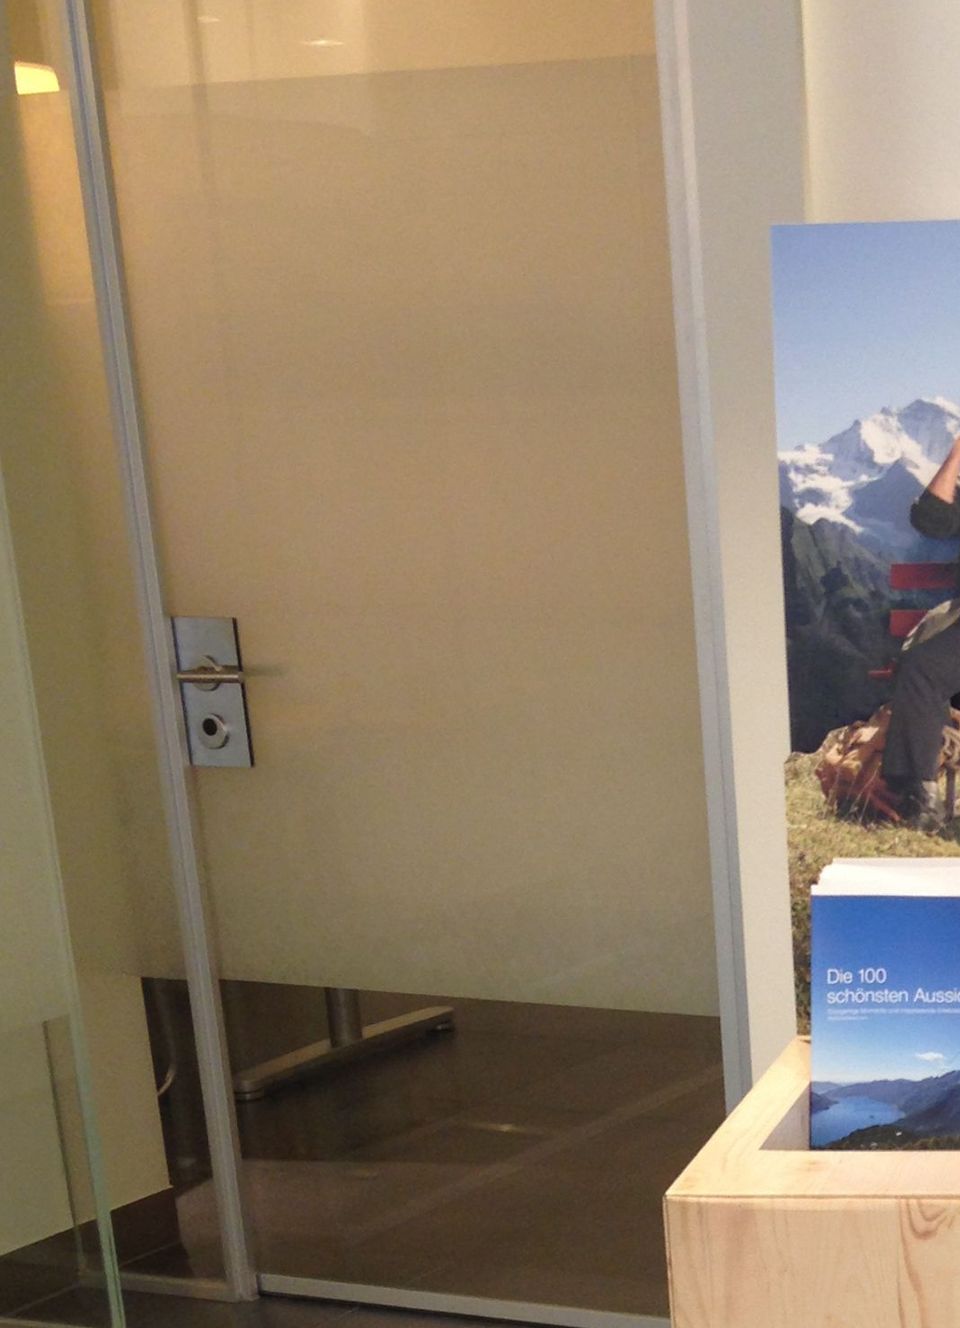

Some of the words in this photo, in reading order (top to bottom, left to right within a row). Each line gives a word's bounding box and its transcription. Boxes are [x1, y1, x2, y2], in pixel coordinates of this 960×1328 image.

[827, 968, 853, 984] Die
[859, 968, 887, 984] 100
[827, 988, 909, 1004] schönsten
